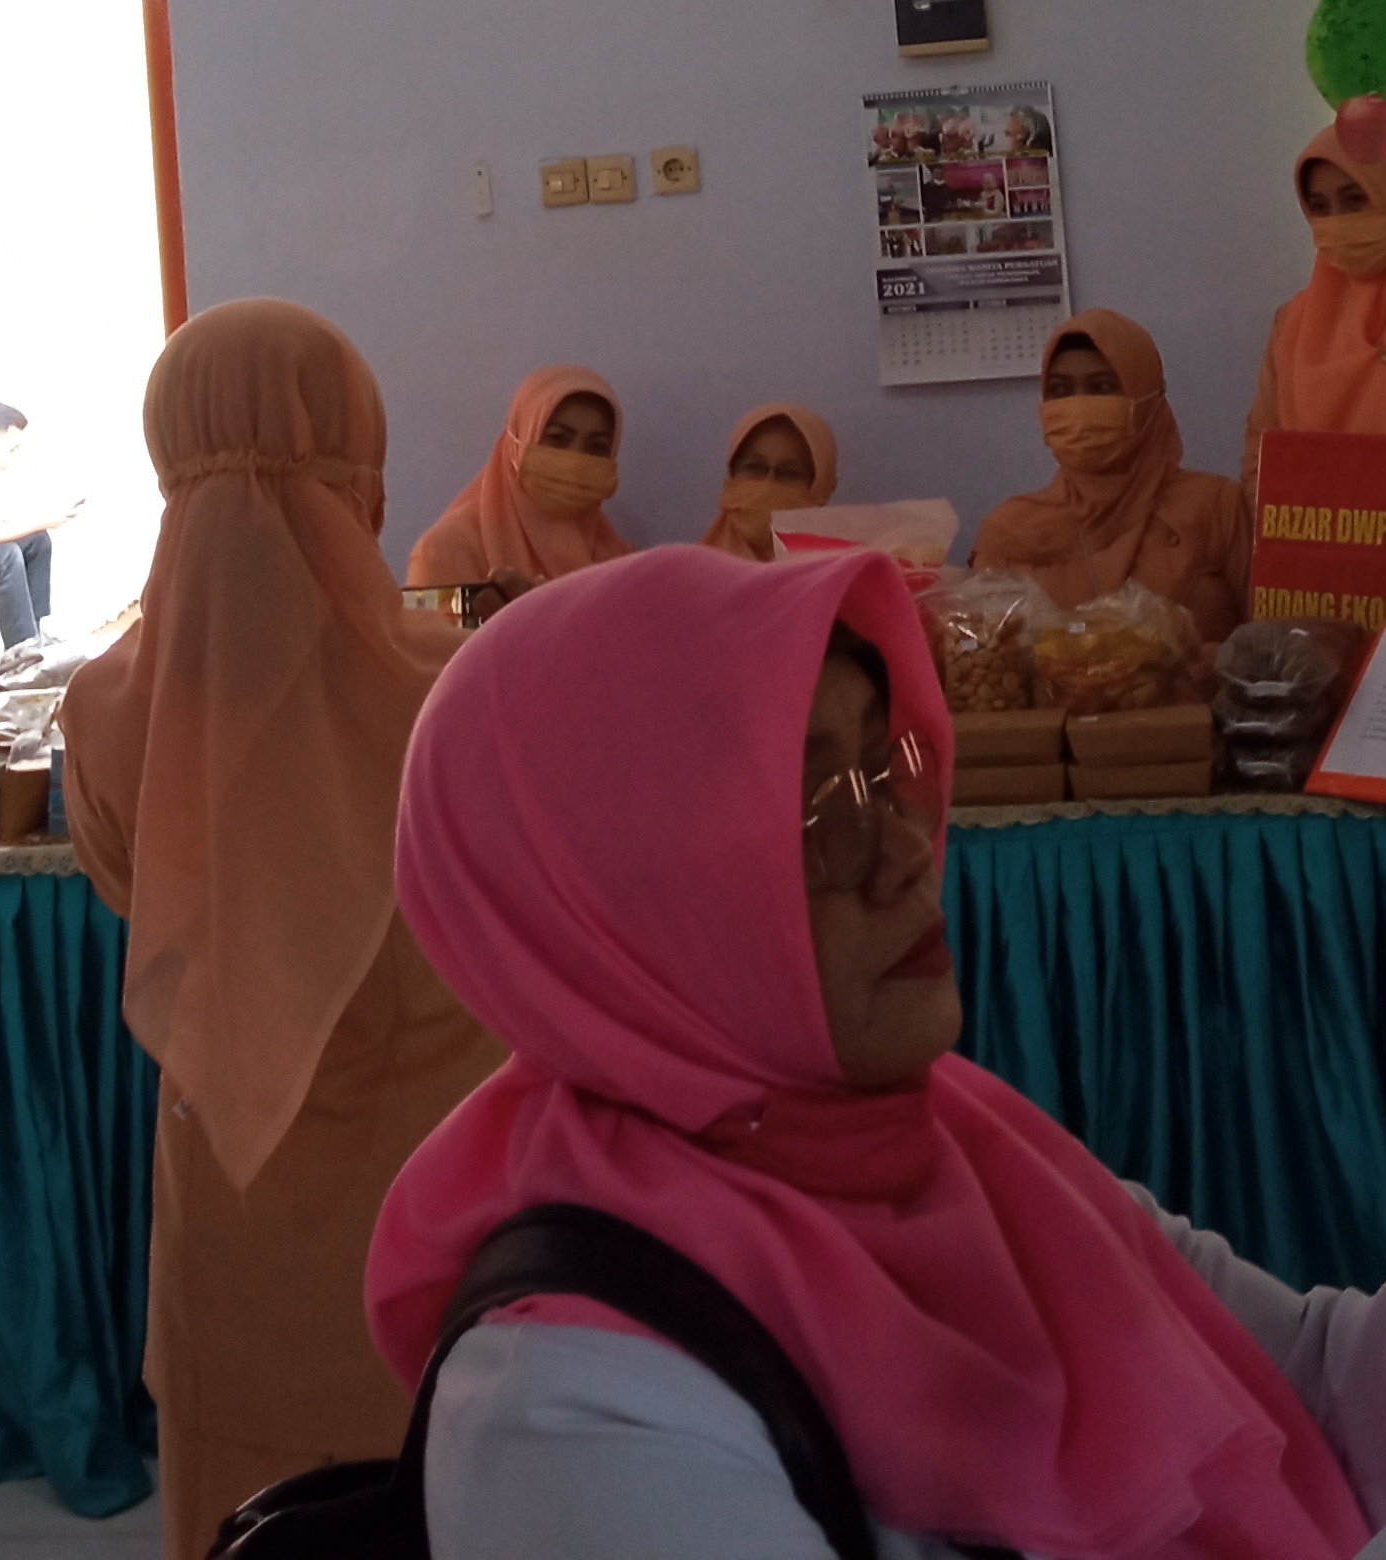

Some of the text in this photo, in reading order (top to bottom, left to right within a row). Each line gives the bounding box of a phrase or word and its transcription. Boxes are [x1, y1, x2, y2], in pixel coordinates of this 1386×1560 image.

[882, 282, 926, 298] 2021
[1262, 503, 1333, 542] BAZAR
[1254, 585, 1337, 622] BIDANG
